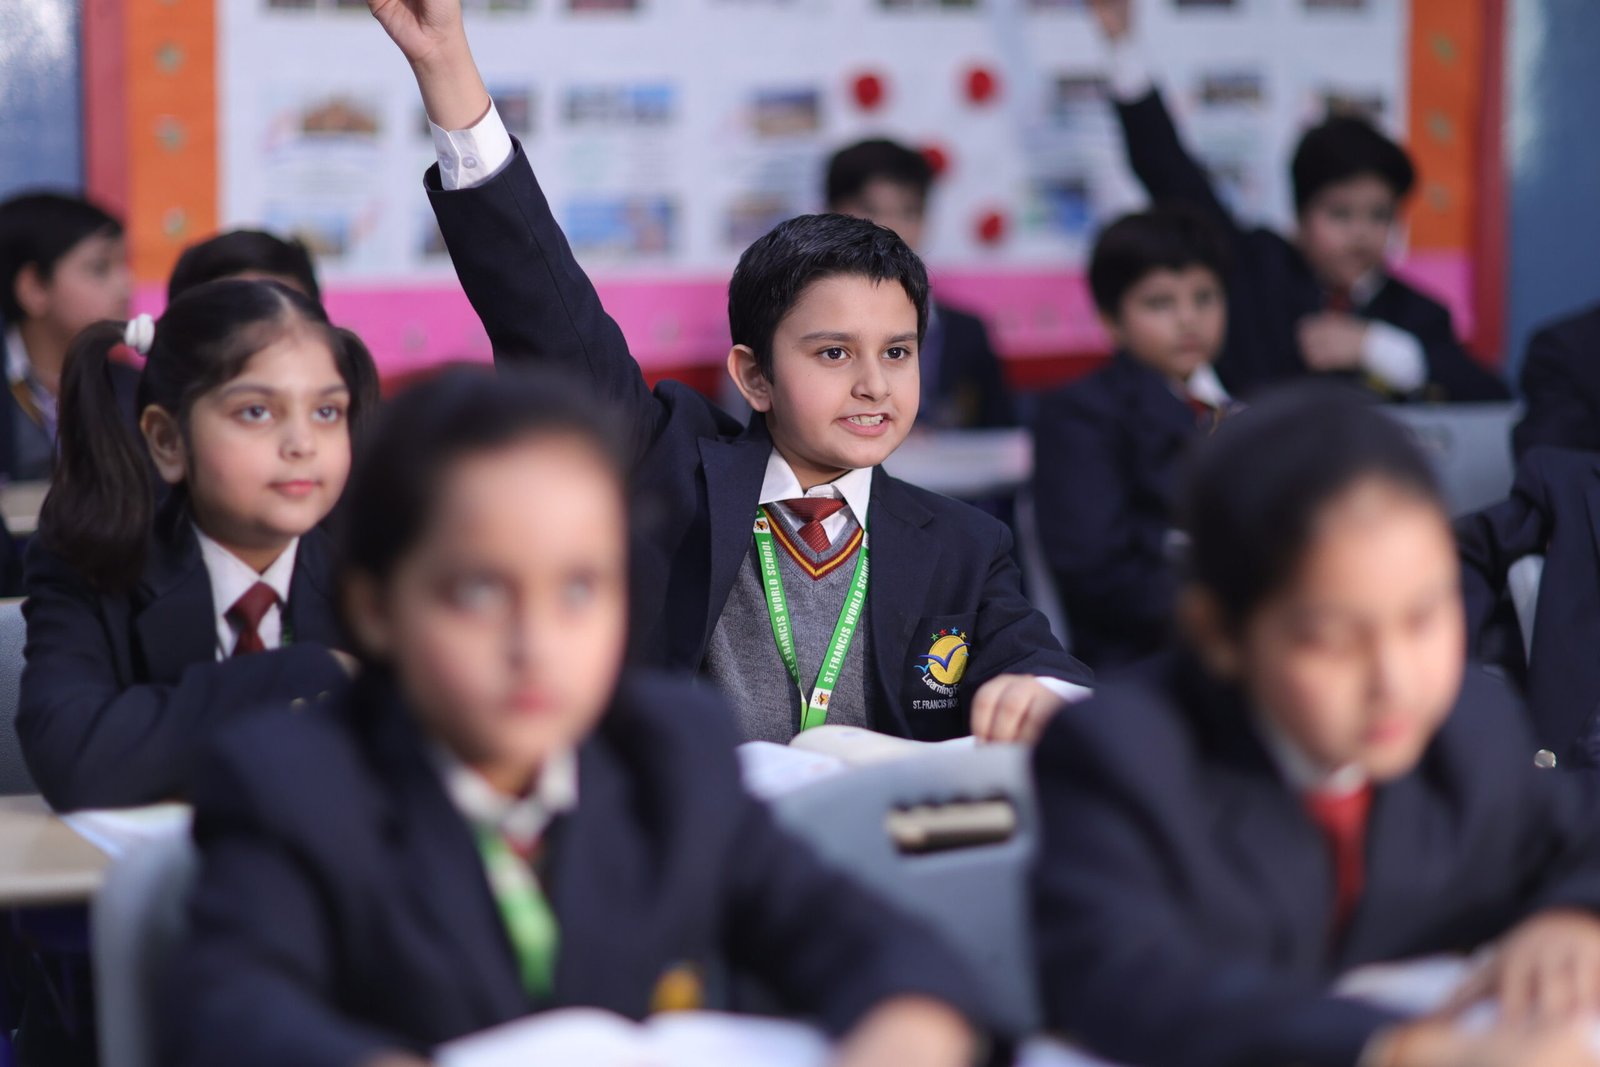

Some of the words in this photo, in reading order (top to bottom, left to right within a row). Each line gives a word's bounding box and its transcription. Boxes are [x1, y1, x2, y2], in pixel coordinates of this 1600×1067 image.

[761, 540, 777, 576] SCHOOL
[769, 578, 784, 614] WORLD
[823, 626, 852, 683] ST.FRANCIS
[845, 590, 863, 625] WORLD
[921, 672, 954, 697] Learning
[912, 699, 947, 710] ST.FRANCIS
